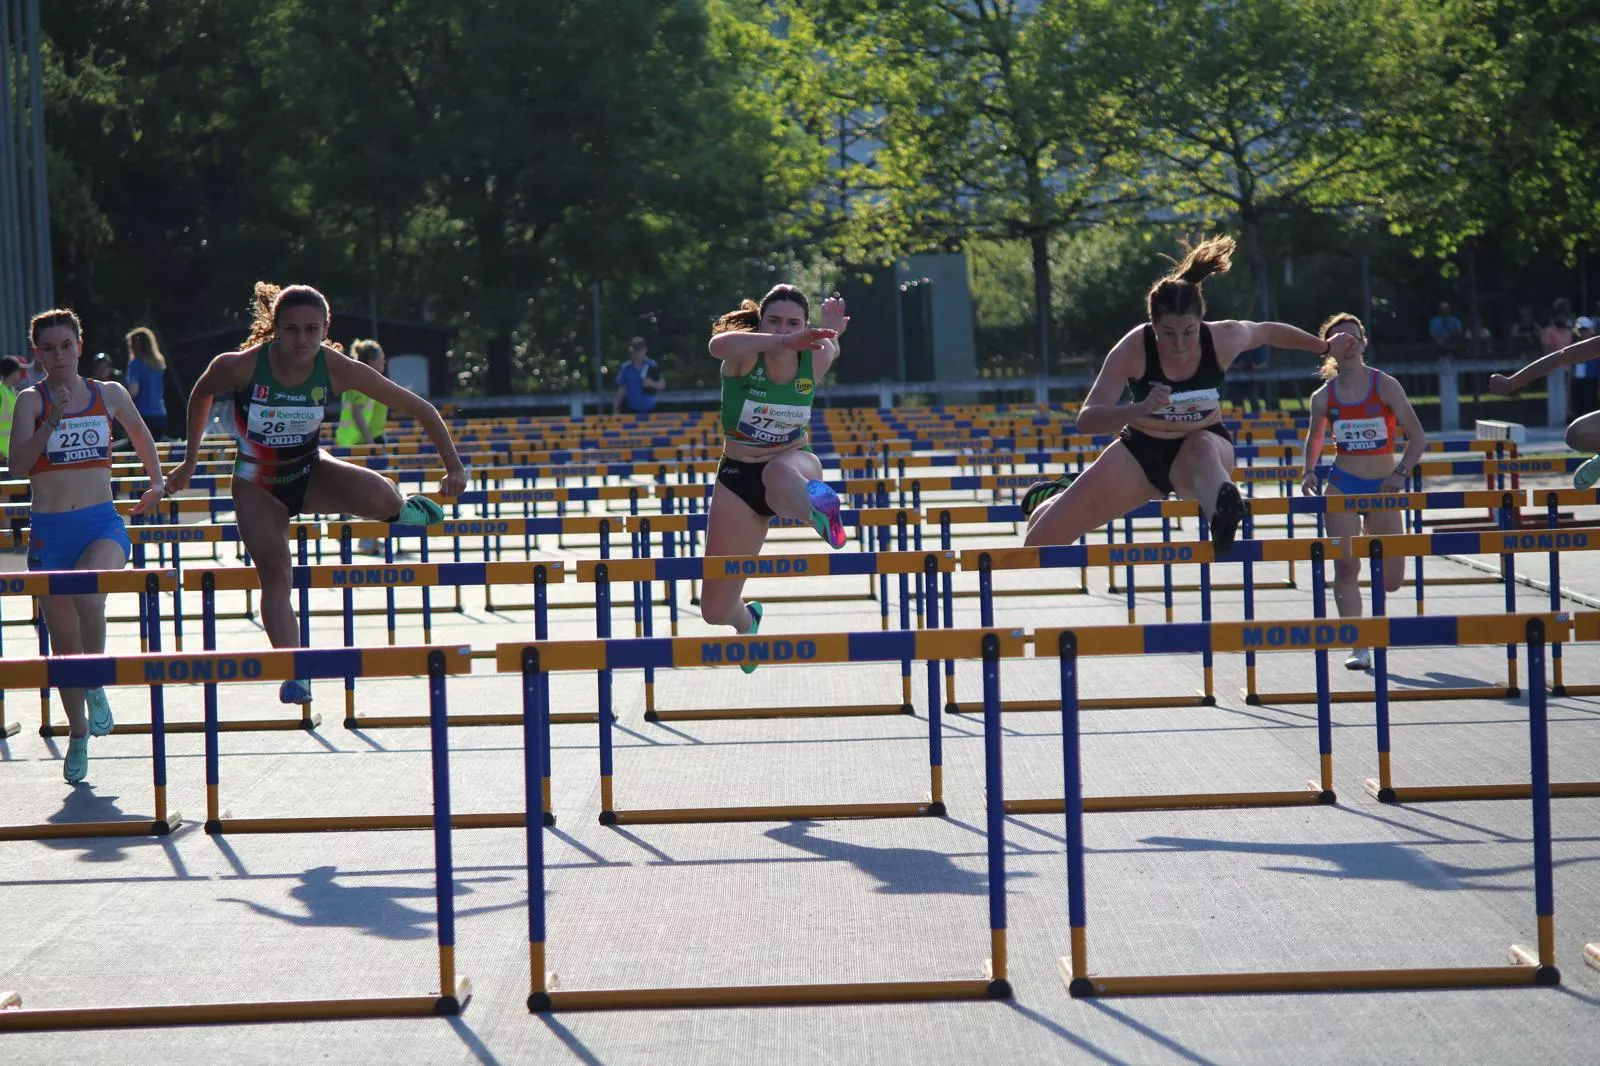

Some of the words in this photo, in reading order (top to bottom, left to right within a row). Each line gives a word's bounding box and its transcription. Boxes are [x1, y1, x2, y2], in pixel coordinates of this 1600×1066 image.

[277, 411, 315, 419] Iberdrola
[769, 408, 804, 418] Iberdrola
[262, 421, 285, 434] 26
[750, 416, 774, 428] 27
[59, 432, 81, 448] 22
[263, 435, 303, 446] Joma
[752, 430, 789, 442] Joma
[1344, 431, 1360, 439] 21
[1347, 441, 1377, 451] Joma
[63, 448, 100, 462] Joma
[1498, 461, 1552, 471] MONDO
[1245, 468, 1298, 478] MONDO
[501, 491, 554, 500] MONDO
[1344, 497, 1409, 510] MONDO
[443, 522, 509, 534] MONDO
[139, 530, 204, 541] MONDO
[1503, 533, 1588, 549] MONDO
[1109, 546, 1193, 563] MONDO
[725, 559, 808, 575] MONDO
[333, 568, 415, 585] MONDO
[1243, 624, 1359, 647] MONDO
[701, 640, 817, 662] MONDO
[144, 658, 263, 682] MONDO
